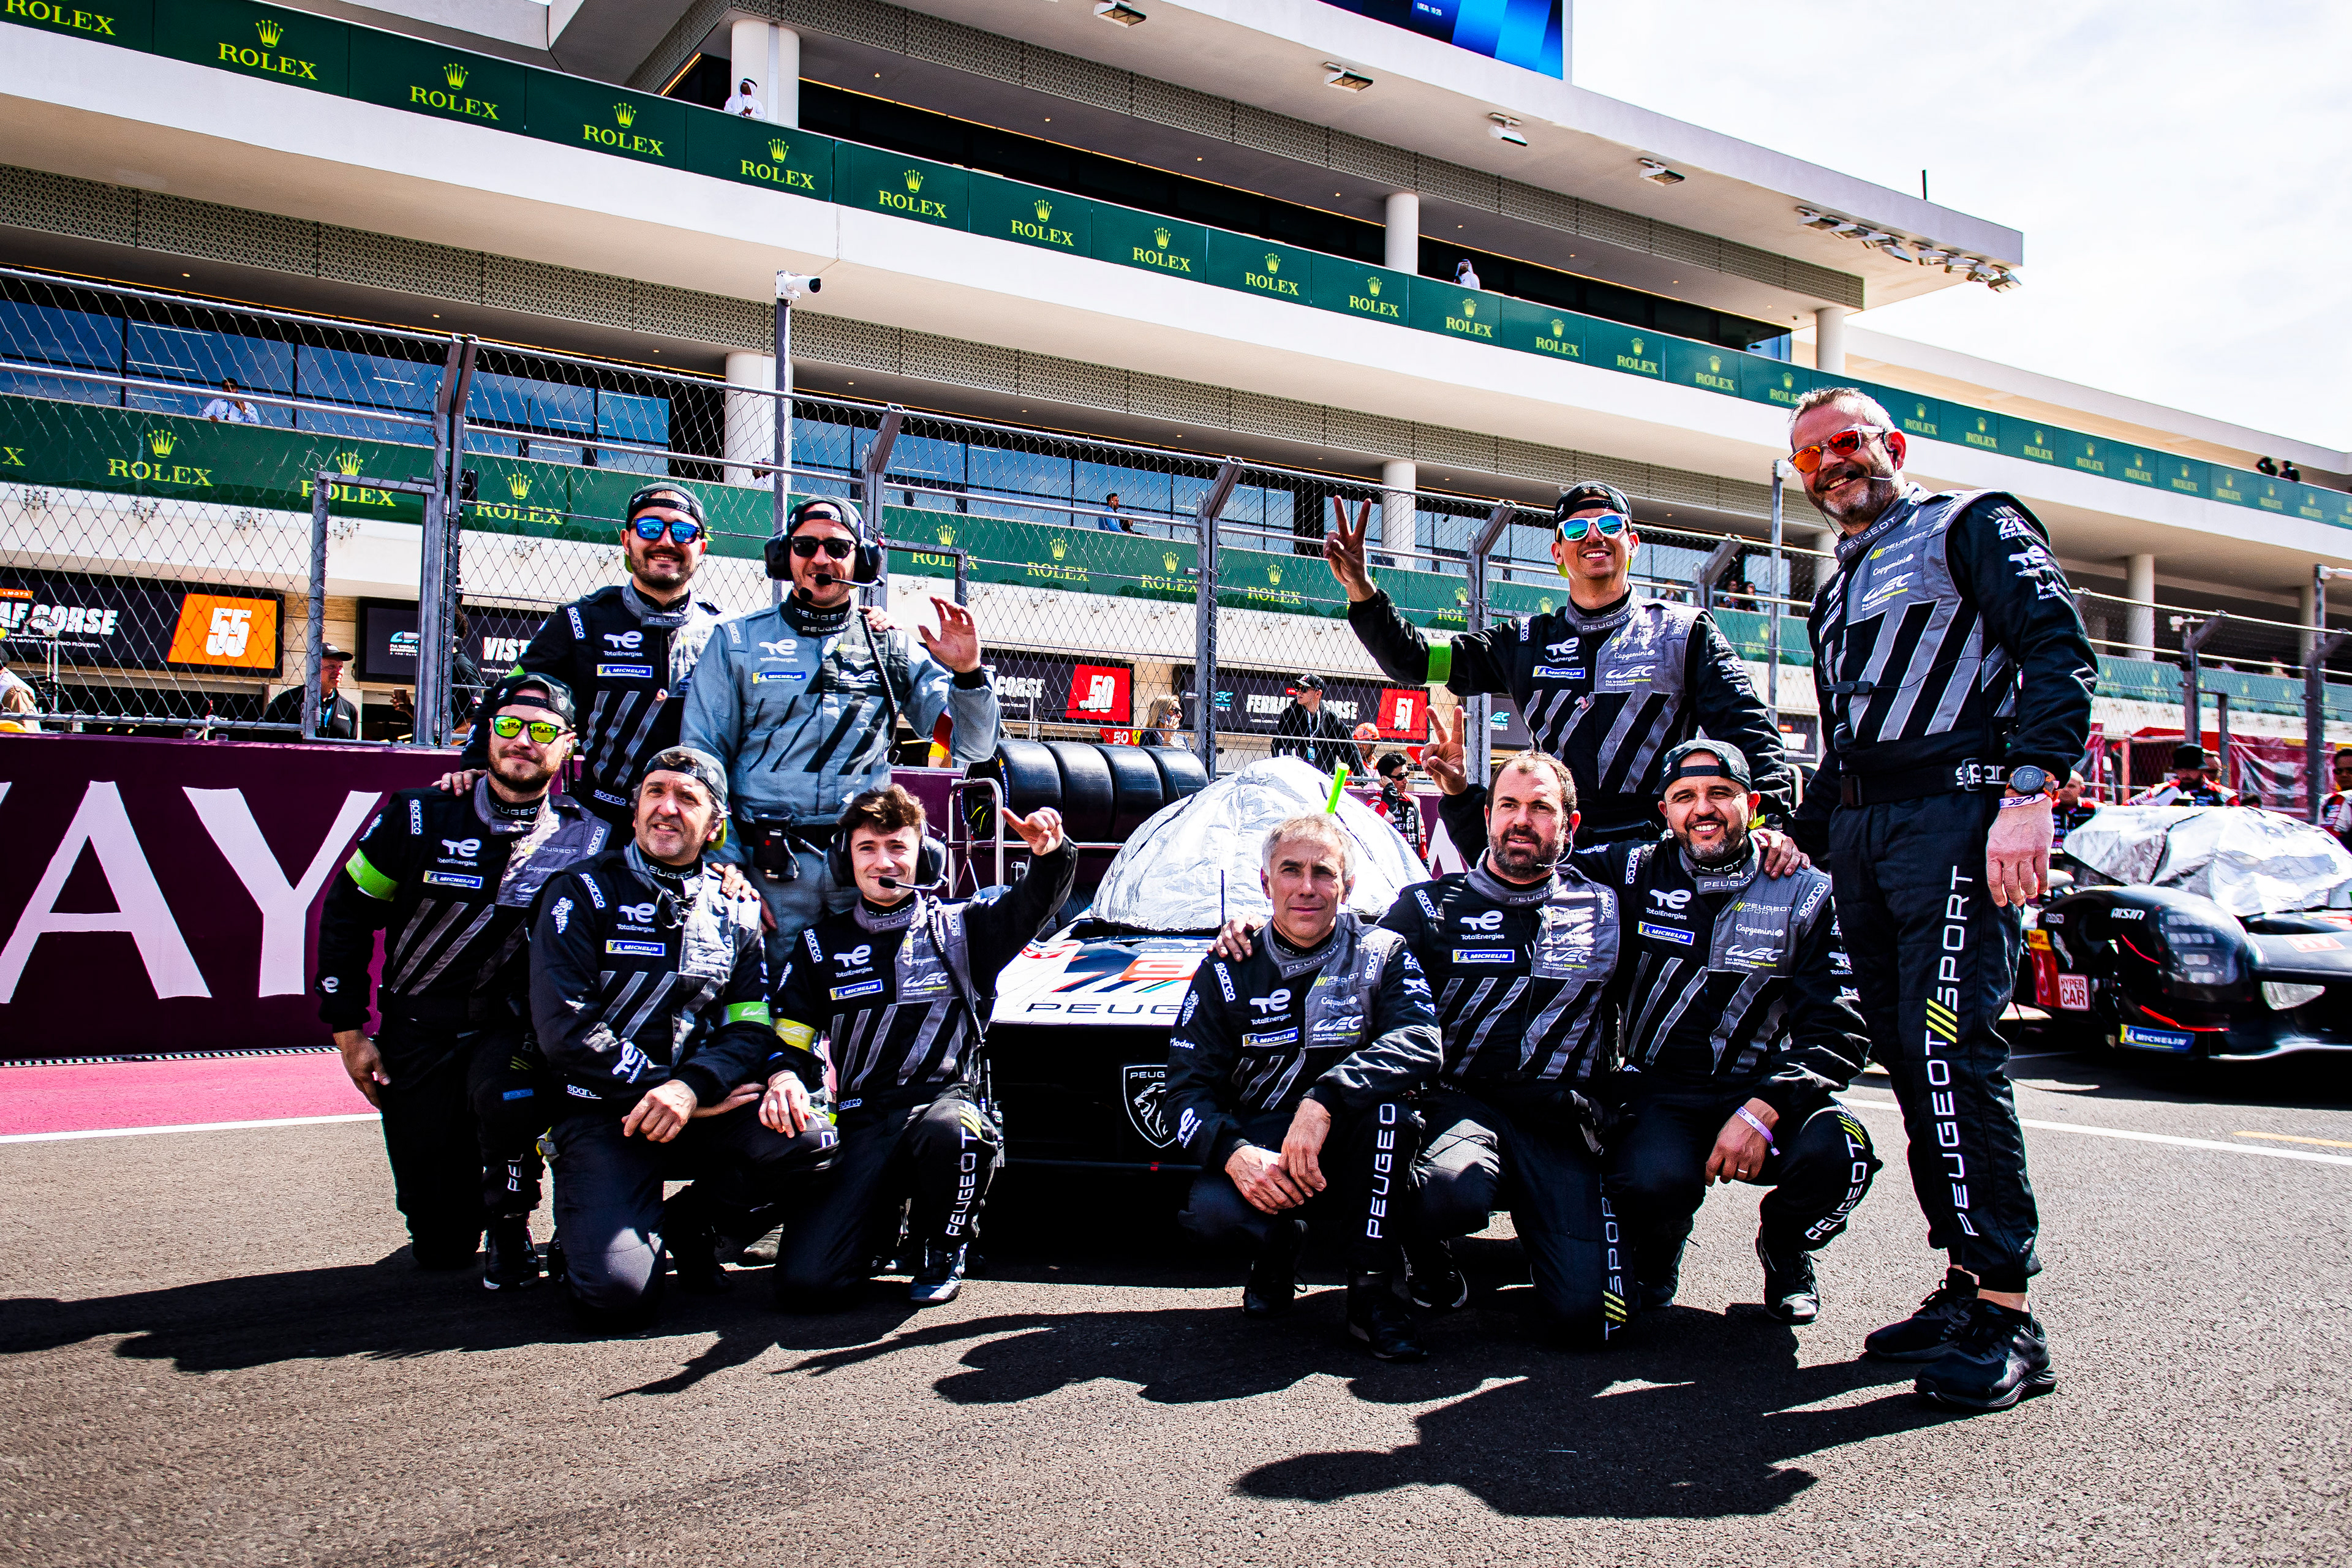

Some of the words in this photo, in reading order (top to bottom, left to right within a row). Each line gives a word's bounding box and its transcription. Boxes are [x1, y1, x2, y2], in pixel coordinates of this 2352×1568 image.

[5, 0, 116, 36] ROLEX
[218, 43, 318, 80] ROLEX
[410, 85, 499, 120] ROLEX
[583, 124, 665, 157] ROLEX
[741, 160, 815, 190] ROLEX
[878, 190, 948, 219] ROLEX
[1011, 220, 1074, 246] ROLEX
[1133, 247, 1191, 273] ROLEX
[1245, 272, 1299, 296] ROLEX
[1349, 295, 1400, 318] ROLEX
[1446, 317, 1493, 338] ROLEX
[1536, 336, 1580, 357] ROLEX
[1616, 355, 1658, 374] ROLEX
[1695, 372, 1735, 391] ROLEX
[1769, 388, 1802, 405] ROLE
[1904, 418, 1937, 435] ROLEX
[1965, 432, 1998, 449] ROLEX
[2023, 445, 2054, 461] ROLEX
[108, 458, 213, 486] ROLEX
[2075, 456, 2105, 472] ROLEX
[476, 500, 563, 526] ROLEX
[1840, 515, 1898, 555] PEUGEOT
[1884, 530, 1931, 550] PEUGEOT
[911, 550, 979, 571] ROLX
[1872, 559, 1907, 576] Capgemini
[1027, 561, 1090, 582] ROLEX
[1246, 586, 1302, 605] ROLEX
[31, 604, 119, 636] CORSE
[567, 606, 586, 639] sparco
[802, 621, 851, 633] PEUGEOT
[1582, 613, 1630, 631] PEUGEOT
[205, 607, 252, 657] 55
[1614, 649, 1647, 661] Capgemini
[1605, 665, 1656, 679] WEC
[1088, 674, 1116, 714] 50
[1394, 697, 1414, 733] 51
[1490, 710, 1511, 723] EC
[1113, 731, 1129, 745] 50
[410, 799, 423, 835] sparco
[586, 825, 605, 856] sparco
[437, 857, 478, 867] TotalEnergies
[1625, 847, 1642, 885] sparco
[439, 876, 477, 885] MICHELIN
[1703, 870, 1755, 889] PEUGEOT
[0, 780, 383, 1004] AY
[579, 872, 607, 910] sparco
[1798, 881, 1828, 919] sparco
[1415, 889, 1438, 918] sparco
[1740, 908, 1776, 916] SPORT
[1743, 902, 1793, 913] PEUGEOT
[1645, 907, 1687, 921] TotalEnergies
[2110, 907, 2146, 921] AISIN
[617, 923, 656, 933] TotalEnergies
[1461, 932, 1505, 941] TotalEnergies
[1652, 929, 1689, 941] MICHELIN
[1735, 923, 1775, 937] Capgemini
[804, 928, 824, 963] sparco
[1937, 865, 1973, 1012] SPORT
[1470, 951, 1509, 960] MICHELIN
[1725, 944, 1784, 962] WEC
[835, 967, 873, 978] TotalEnergies
[902, 972, 949, 989] WEC
[844, 984, 878, 995] MICHELIN
[1215, 962, 1236, 1003] sparco
[2060, 979, 2085, 990] HYPER
[2062, 989, 2086, 1006] CAR
[1251, 1014, 1292, 1025] TotalEnergies
[1313, 1014, 1364, 1031] WEC
[1170, 1037, 1195, 1050] Modex
[1260, 1033, 1296, 1044] MICHELIN
[2136, 1033, 2188, 1046] MICHELIN
[627, 1054, 648, 1084] TotalEnergies
[1925, 1030, 1980, 1237] PEUGEOT
[946, 1126, 979, 1237] PEUGEOT
[1804, 1133, 1867, 1242] PEUGEOT
